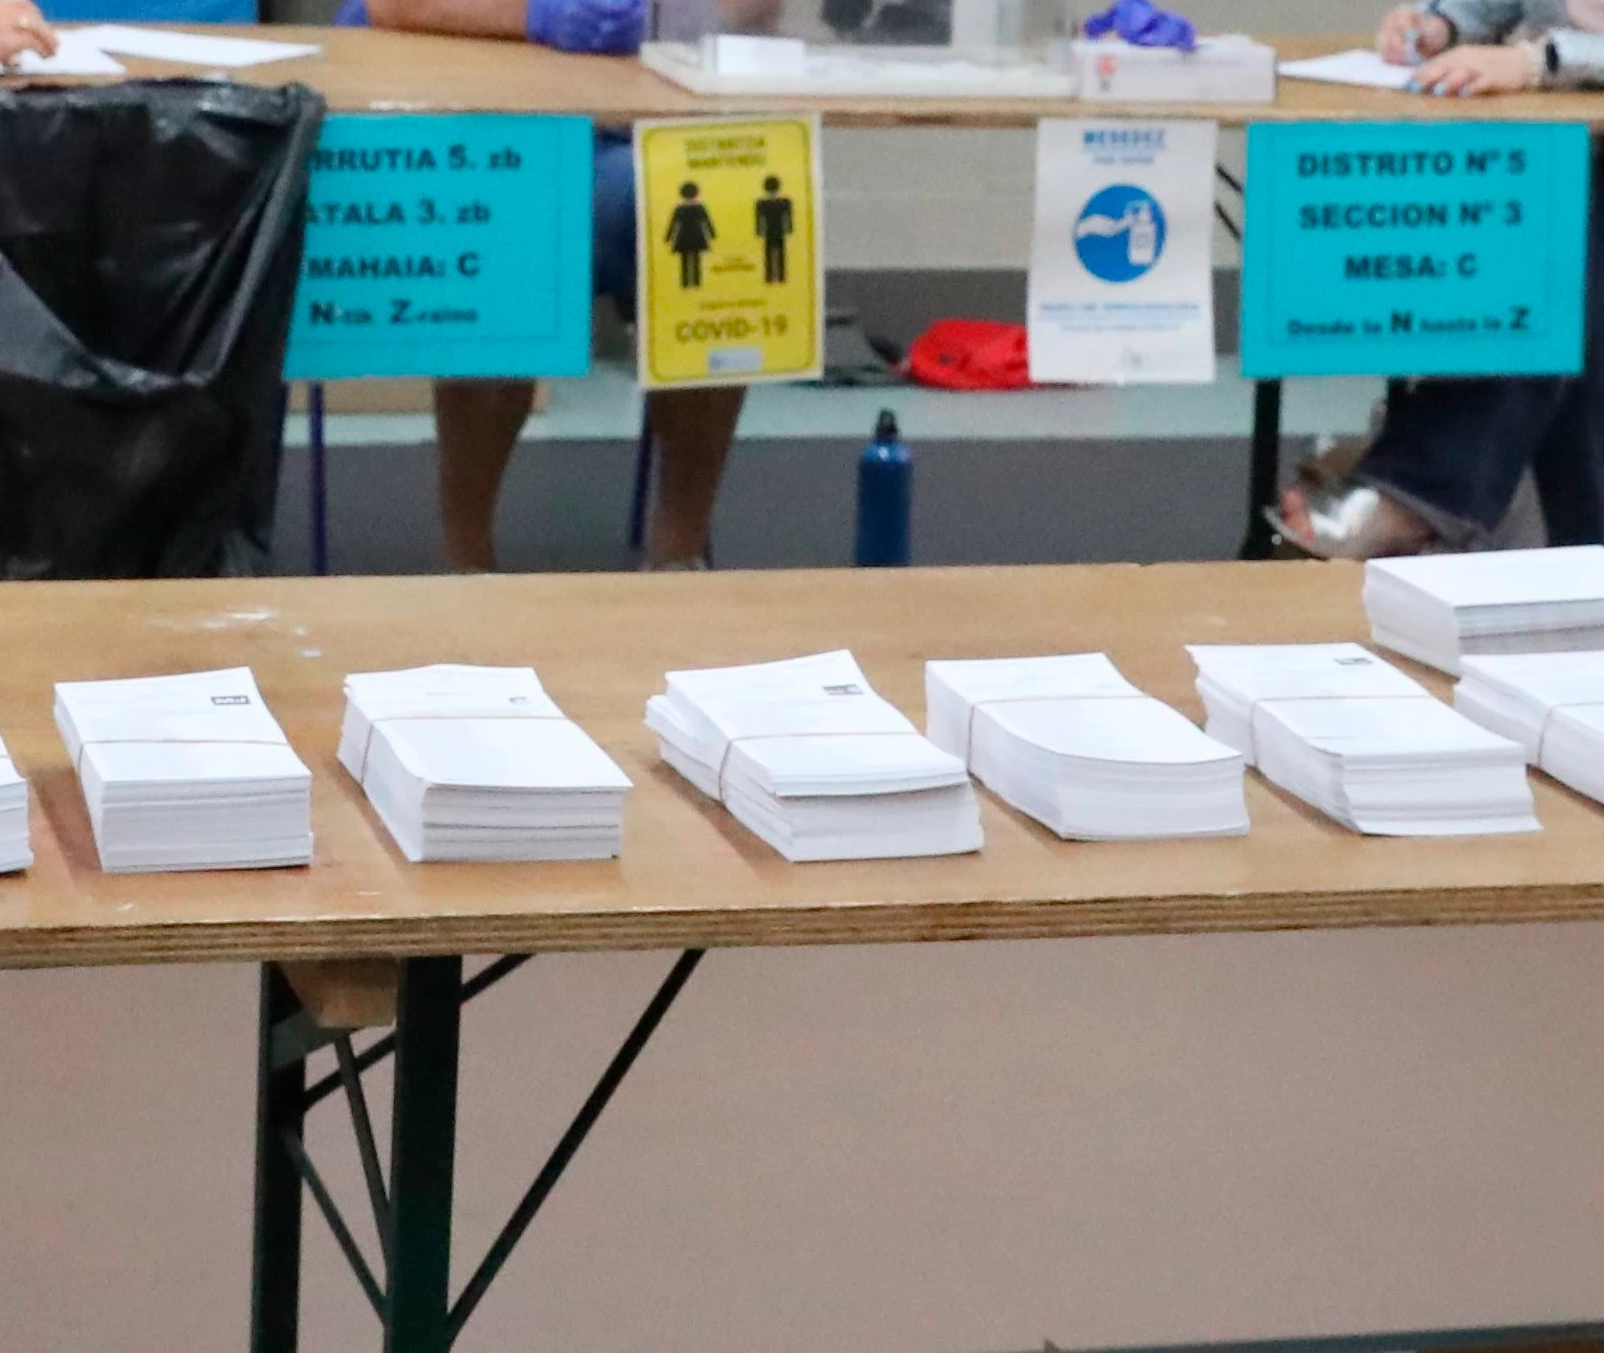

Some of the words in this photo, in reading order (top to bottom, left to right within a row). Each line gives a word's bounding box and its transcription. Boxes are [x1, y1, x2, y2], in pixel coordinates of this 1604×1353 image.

[449, 145, 476, 170] 5.
[488, 147, 521, 170] zb
[1298, 151, 1453, 177] DISTRITO
[1507, 149, 1527, 175] 5
[417, 198, 445, 225] 3.
[456, 200, 491, 224] zb
[1299, 203, 1448, 229] SECCION
[1503, 200, 1523, 226] 3
[307, 256, 445, 278] MAHAIA:
[458, 252, 480, 277] C
[1344, 255, 1446, 279] MESA:
[1457, 253, 1477, 278] C
[675, 314, 788, 344] COVID-19
[1390, 310, 1413, 334] N
[1510, 305, 1530, 331] Z
